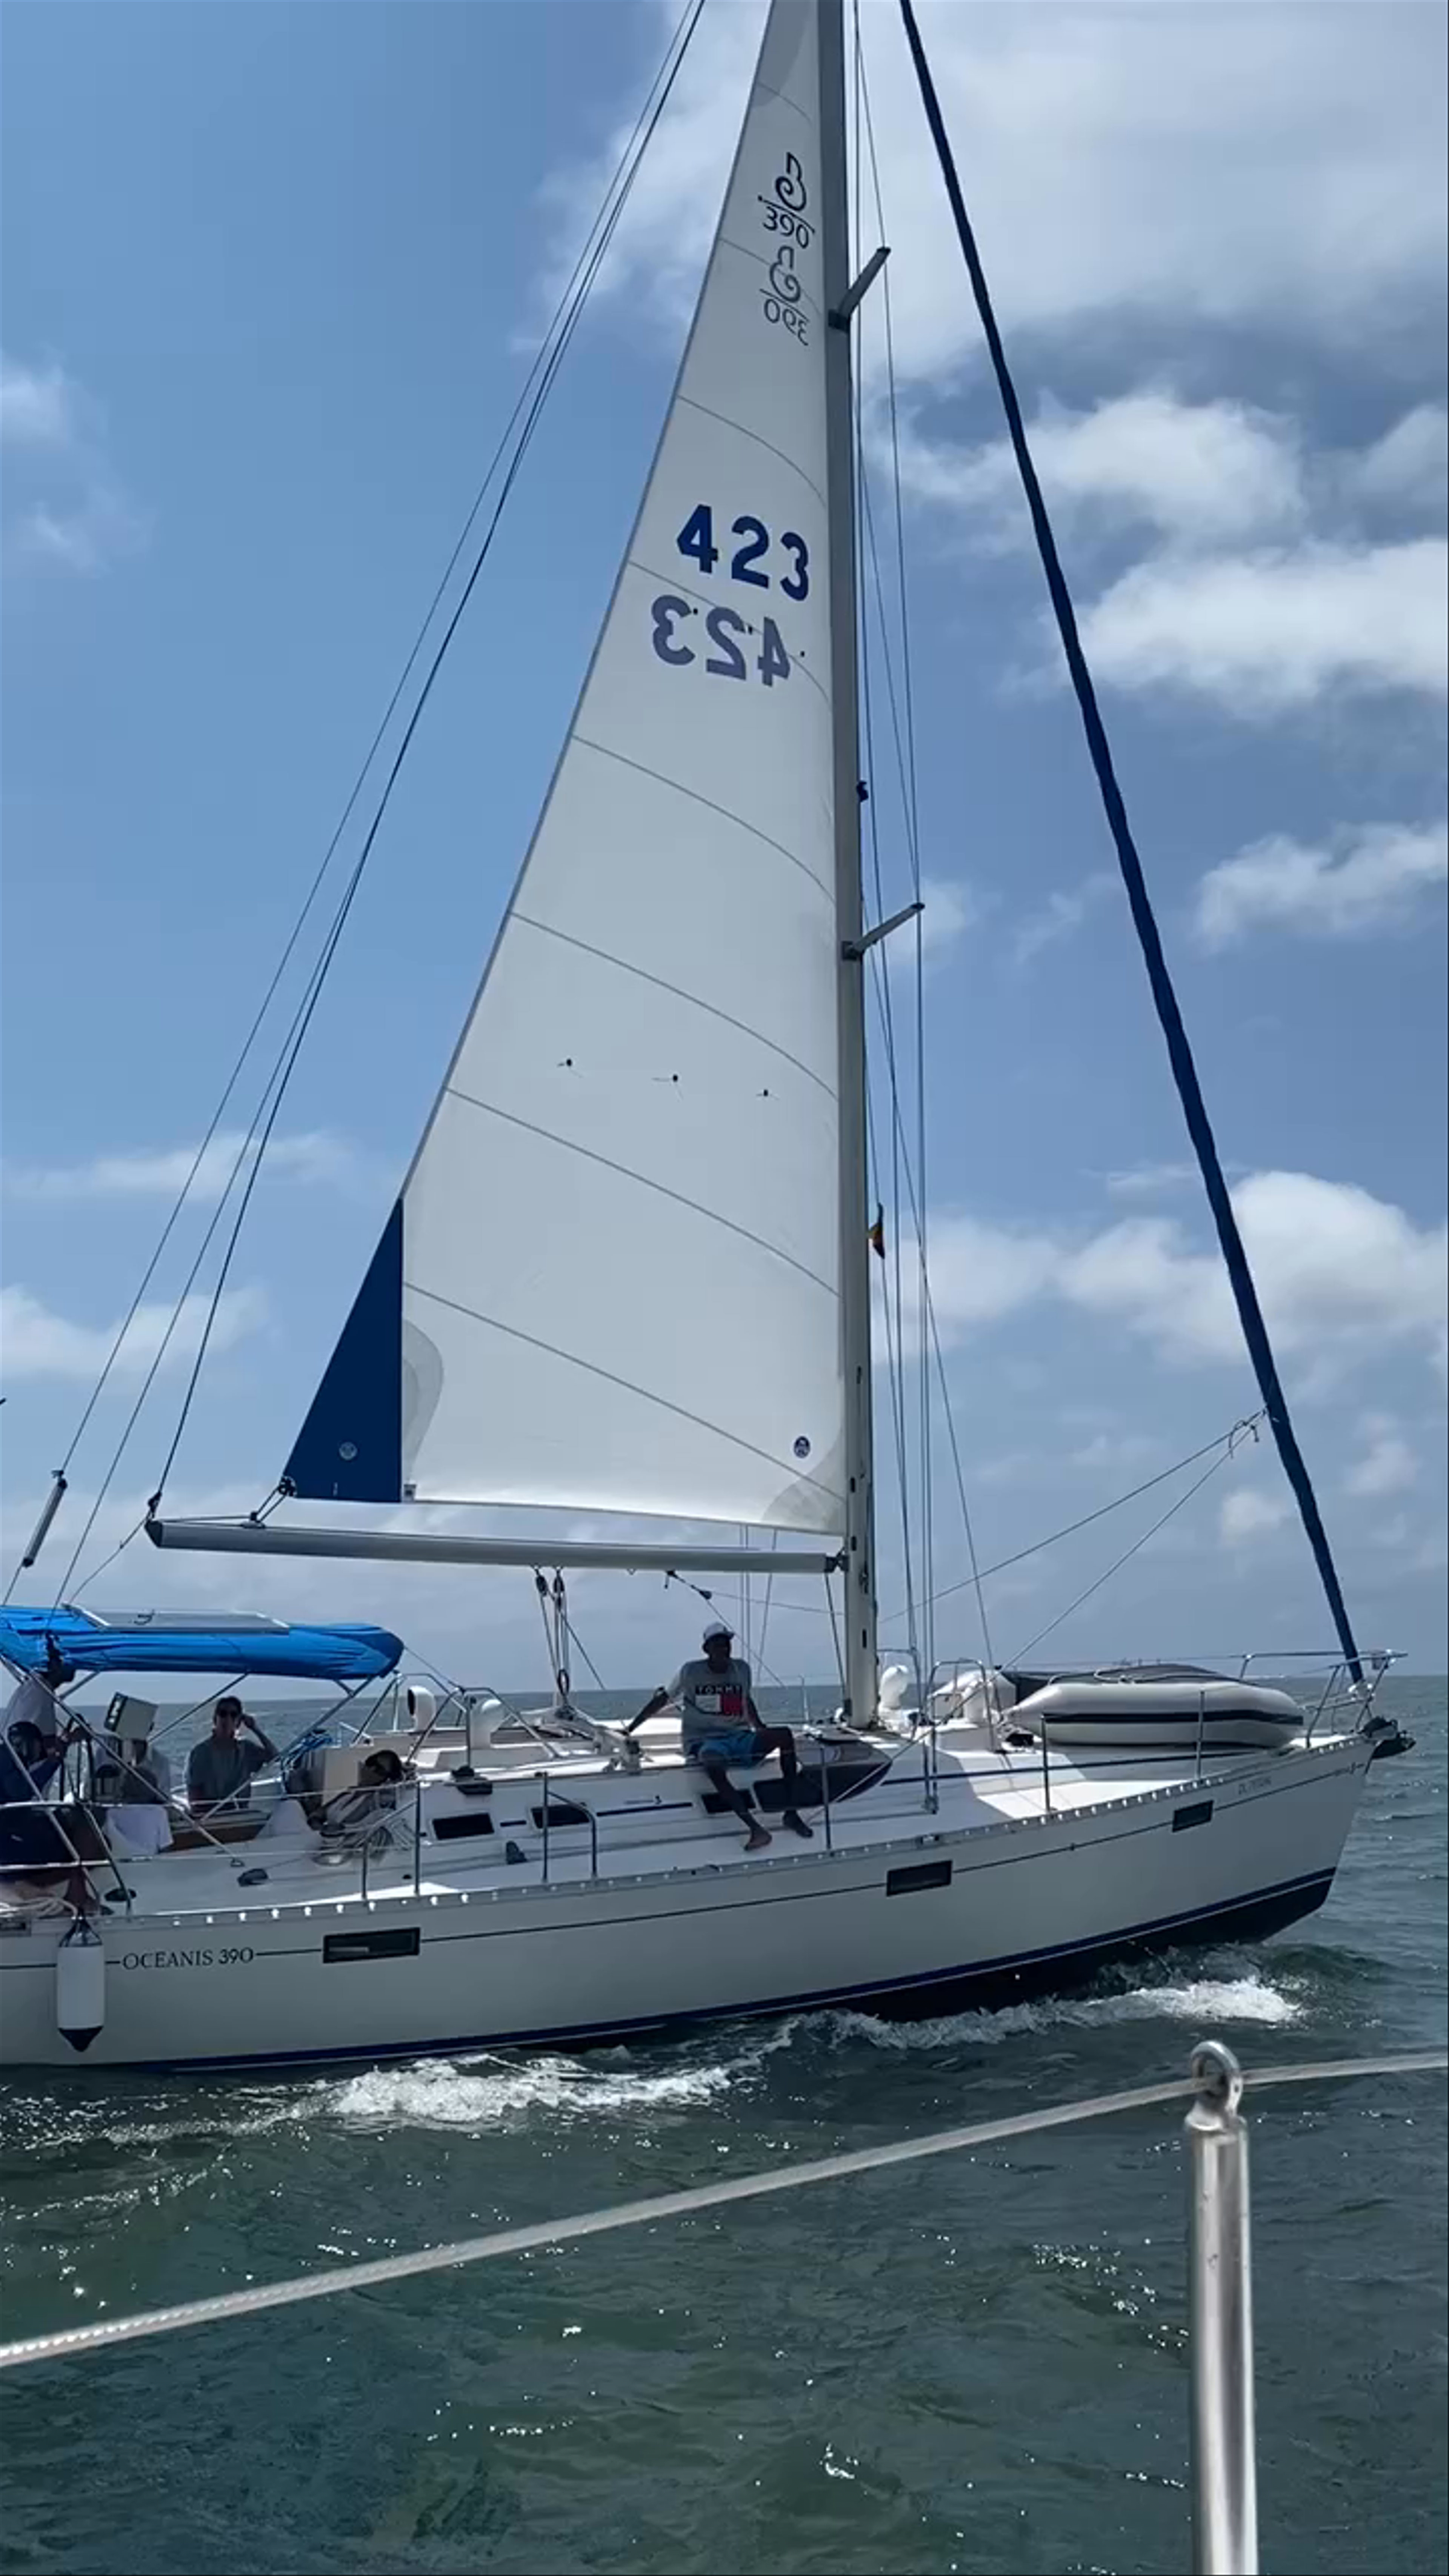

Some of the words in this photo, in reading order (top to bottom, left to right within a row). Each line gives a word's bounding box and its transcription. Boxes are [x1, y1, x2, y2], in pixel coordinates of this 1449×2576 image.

[763, 205, 809, 249] 390
[677, 504, 809, 601] 423
[123, 1950, 213, 1970] OCEANIS
[218, 1947, 254, 1964] 390
